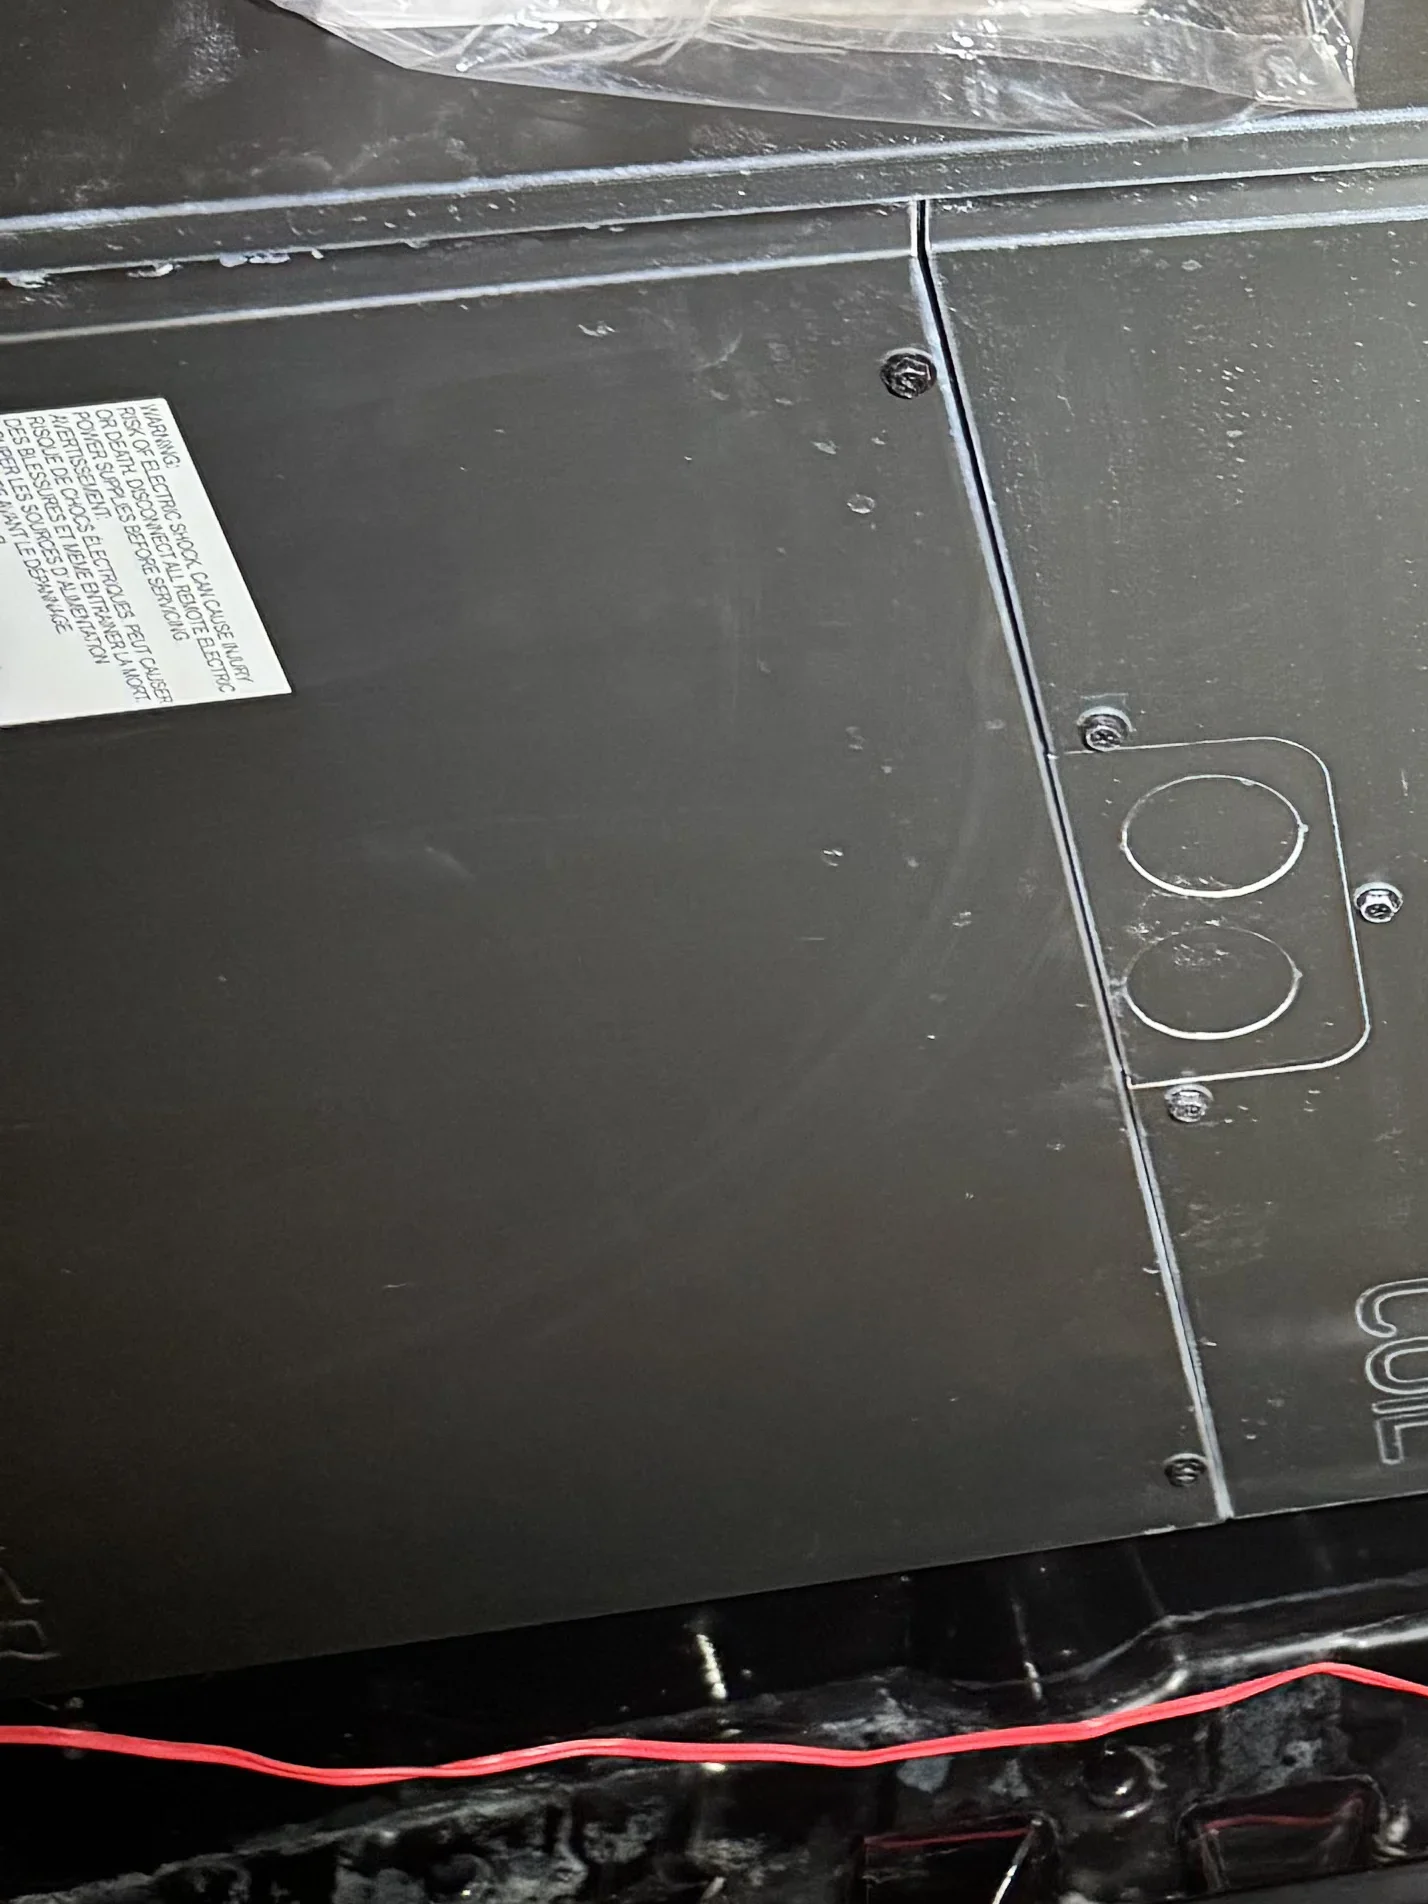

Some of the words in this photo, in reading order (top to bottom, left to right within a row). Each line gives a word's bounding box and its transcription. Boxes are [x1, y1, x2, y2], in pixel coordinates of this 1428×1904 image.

[3, 418, 31, 446] DES
[26, 416, 64, 464] RISQUE
[117, 406, 146, 437] RISK
[139, 404, 181, 469] WARNING:
[49, 413, 113, 521] AVERTISSEMENT:
[132, 439, 155, 457] OF
[17, 448, 67, 523] BLESSURES
[50, 467, 73, 485] DE
[141, 460, 182, 521] ELECTRIC
[8, 478, 34, 503] LES
[21, 504, 64, 565] SOURCES
[60, 487, 96, 533] CHOCS
[73, 411, 108, 460] POWER
[95, 462, 136, 523] SUPPLIES
[124, 524, 161, 575] BEFORE
[148, 577, 190, 641] SERVICING
[14, 541, 37, 557] LE
[53, 524, 77, 540] ET
[95, 409, 117, 429] OR
[126, 478, 177, 559] DISCONNECT
[162, 561, 184, 583] ALL
[173, 584, 209, 635] REMOTE
[197, 637, 236, 693] ELECTRIC
[170, 523, 202, 570] SHOCK
[190, 572, 215, 597] CAN
[124, 623, 153, 655] PEUT
[203, 599, 234, 641] CAUSE
[113, 652, 134, 667] LA
[139, 657, 174, 704] CAUSER
[222, 642, 254, 683] INJURY
[122, 668, 151, 703] MORT.
